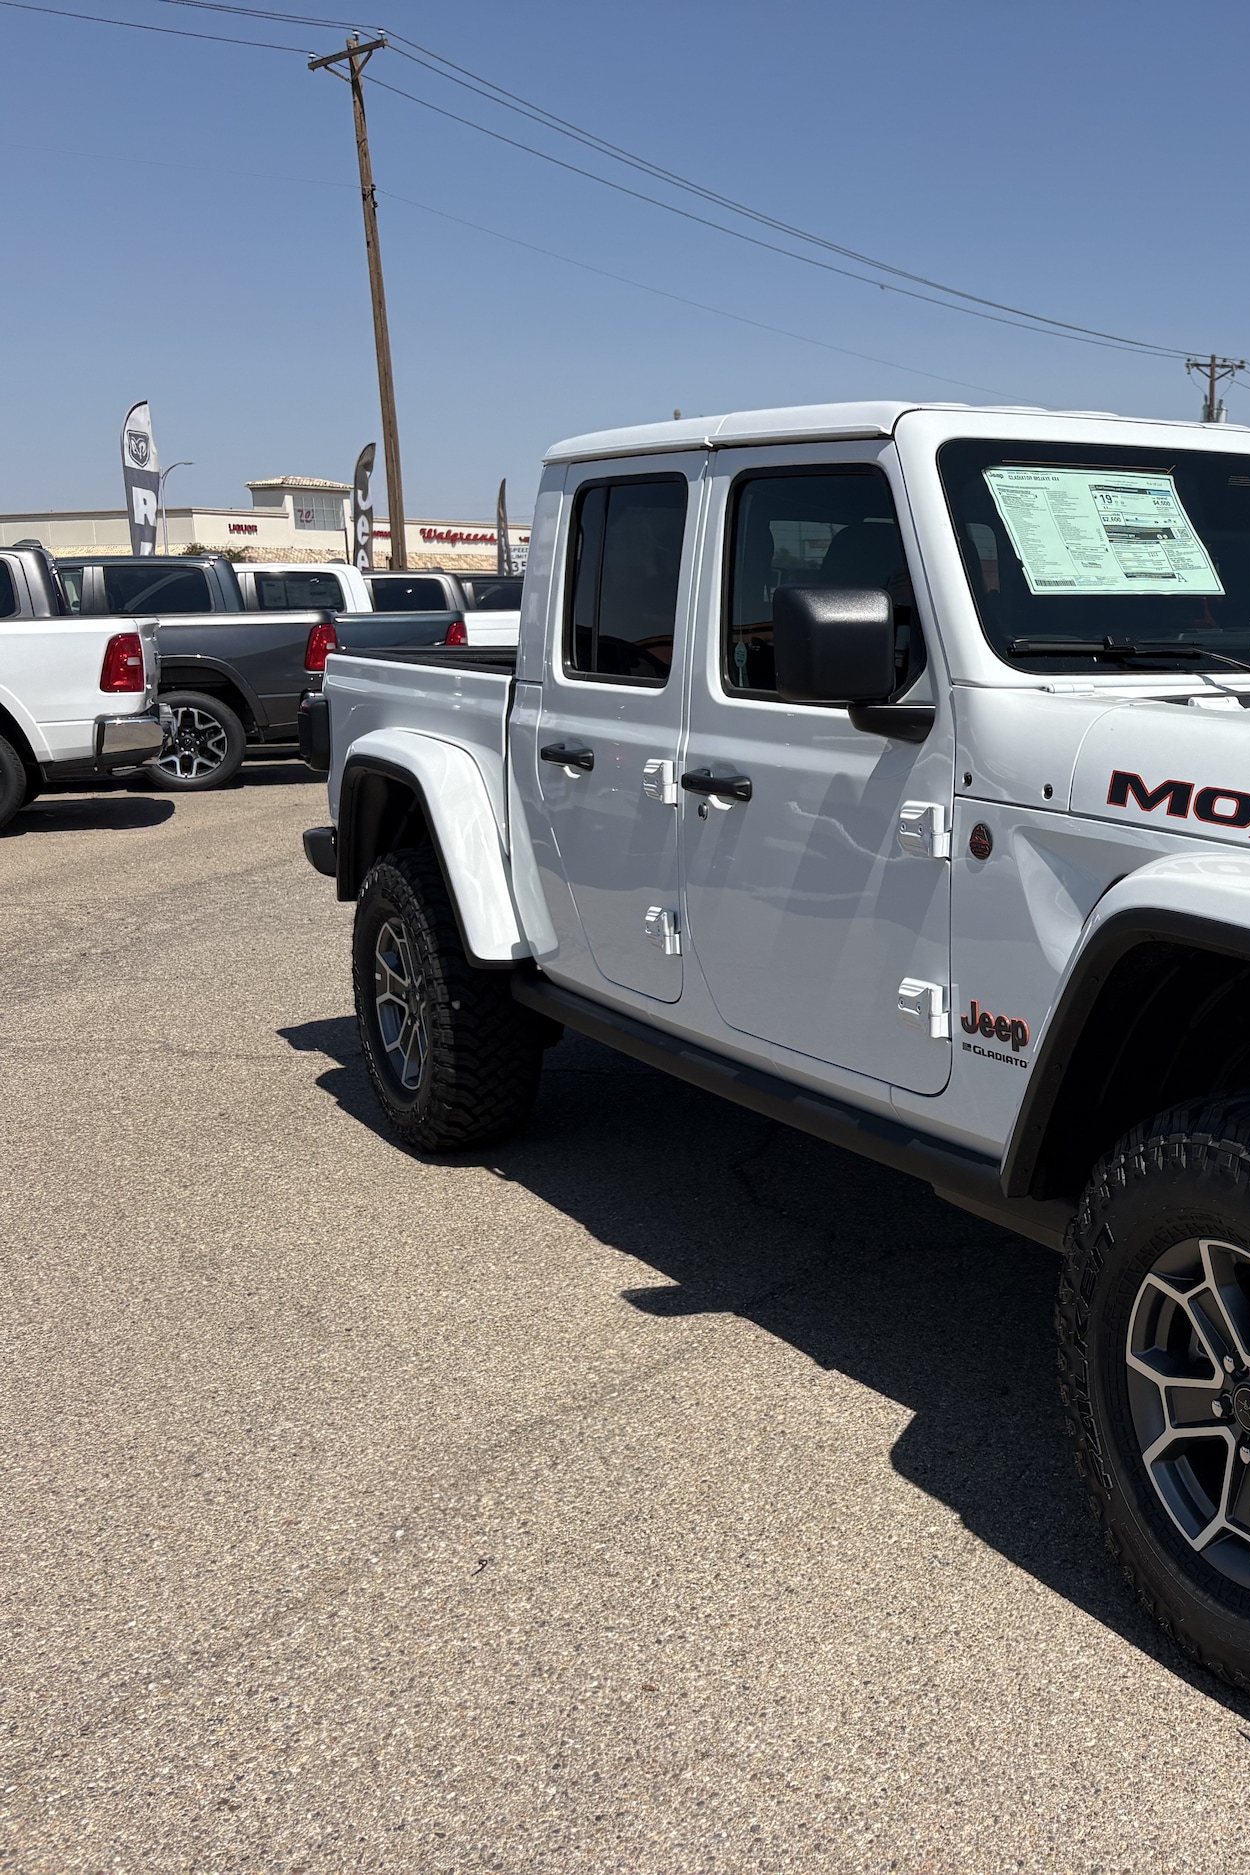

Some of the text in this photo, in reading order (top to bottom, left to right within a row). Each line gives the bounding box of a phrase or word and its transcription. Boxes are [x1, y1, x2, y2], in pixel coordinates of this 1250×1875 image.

[1100, 494, 1113, 504] 19
[228, 523, 258, 534] LIQUOR
[420, 528, 497, 545] Walgreens
[961, 999, 1030, 1052] Jeep
